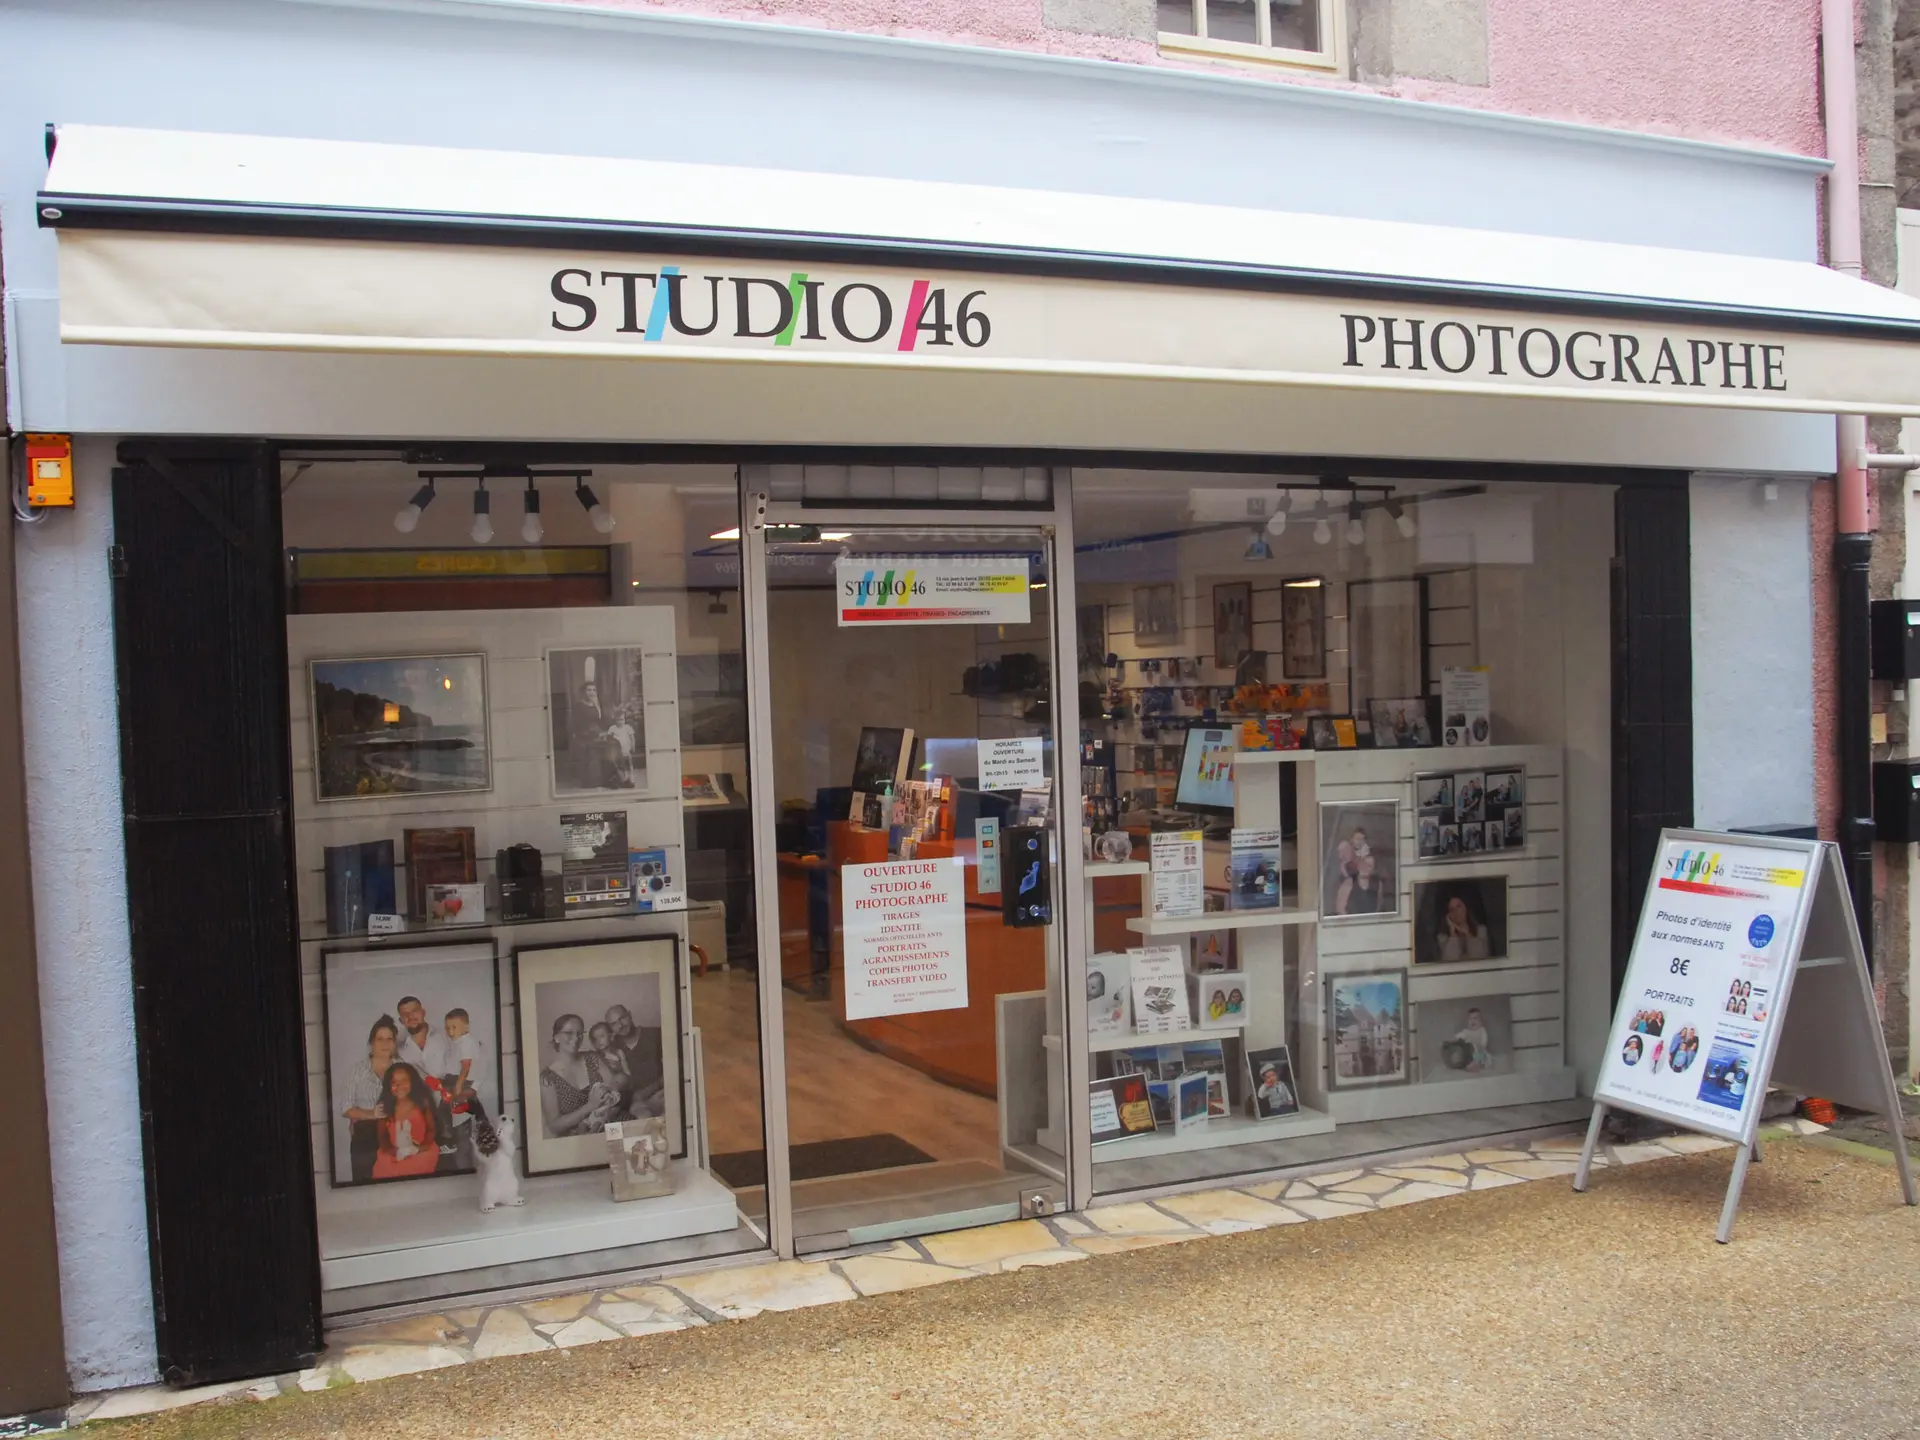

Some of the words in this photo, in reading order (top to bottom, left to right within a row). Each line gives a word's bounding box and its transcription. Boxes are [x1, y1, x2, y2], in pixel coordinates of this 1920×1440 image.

[550, 268, 893, 343] STUDIO
[916, 288, 991, 348] 46
[1340, 313, 1788, 391] PHOTOGRAPHE
[845, 580, 907, 596] STUDIO
[910, 580, 926, 595] 46
[863, 863, 937, 878] OUVERTURE
[1666, 858, 1711, 876] STUDIO
[1713, 863, 1724, 877] 46
[870, 881, 917, 894] STUDIO
[920, 880, 932, 890] 46
[855, 893, 948, 910] PHOTOGRAPHE
[882, 911, 920, 921] TIRAGES
[1656, 910, 1689, 926] Photos
[1690, 916, 1732, 932] d'identité
[881, 923, 922, 934] IDENTITE
[863, 936, 889, 944] NORMES
[927, 931, 943, 939] ANTS
[1650, 930, 1668, 940] aux
[1670, 932, 1702, 946] normes
[1702, 939, 1725, 951] ANTS
[877, 942, 927, 953] PORTRAITS
[862, 951, 950, 965] AGRANDISSEMENTS
[869, 965, 900, 976] COPIES
[902, 963, 938, 973] PHOTOS
[1670, 957, 1691, 976] 8€
[866, 976, 917, 988] TRANSFERT
[918, 973, 947, 983] VIDEO
[1644, 988, 1694, 1008] PORTRAITS
